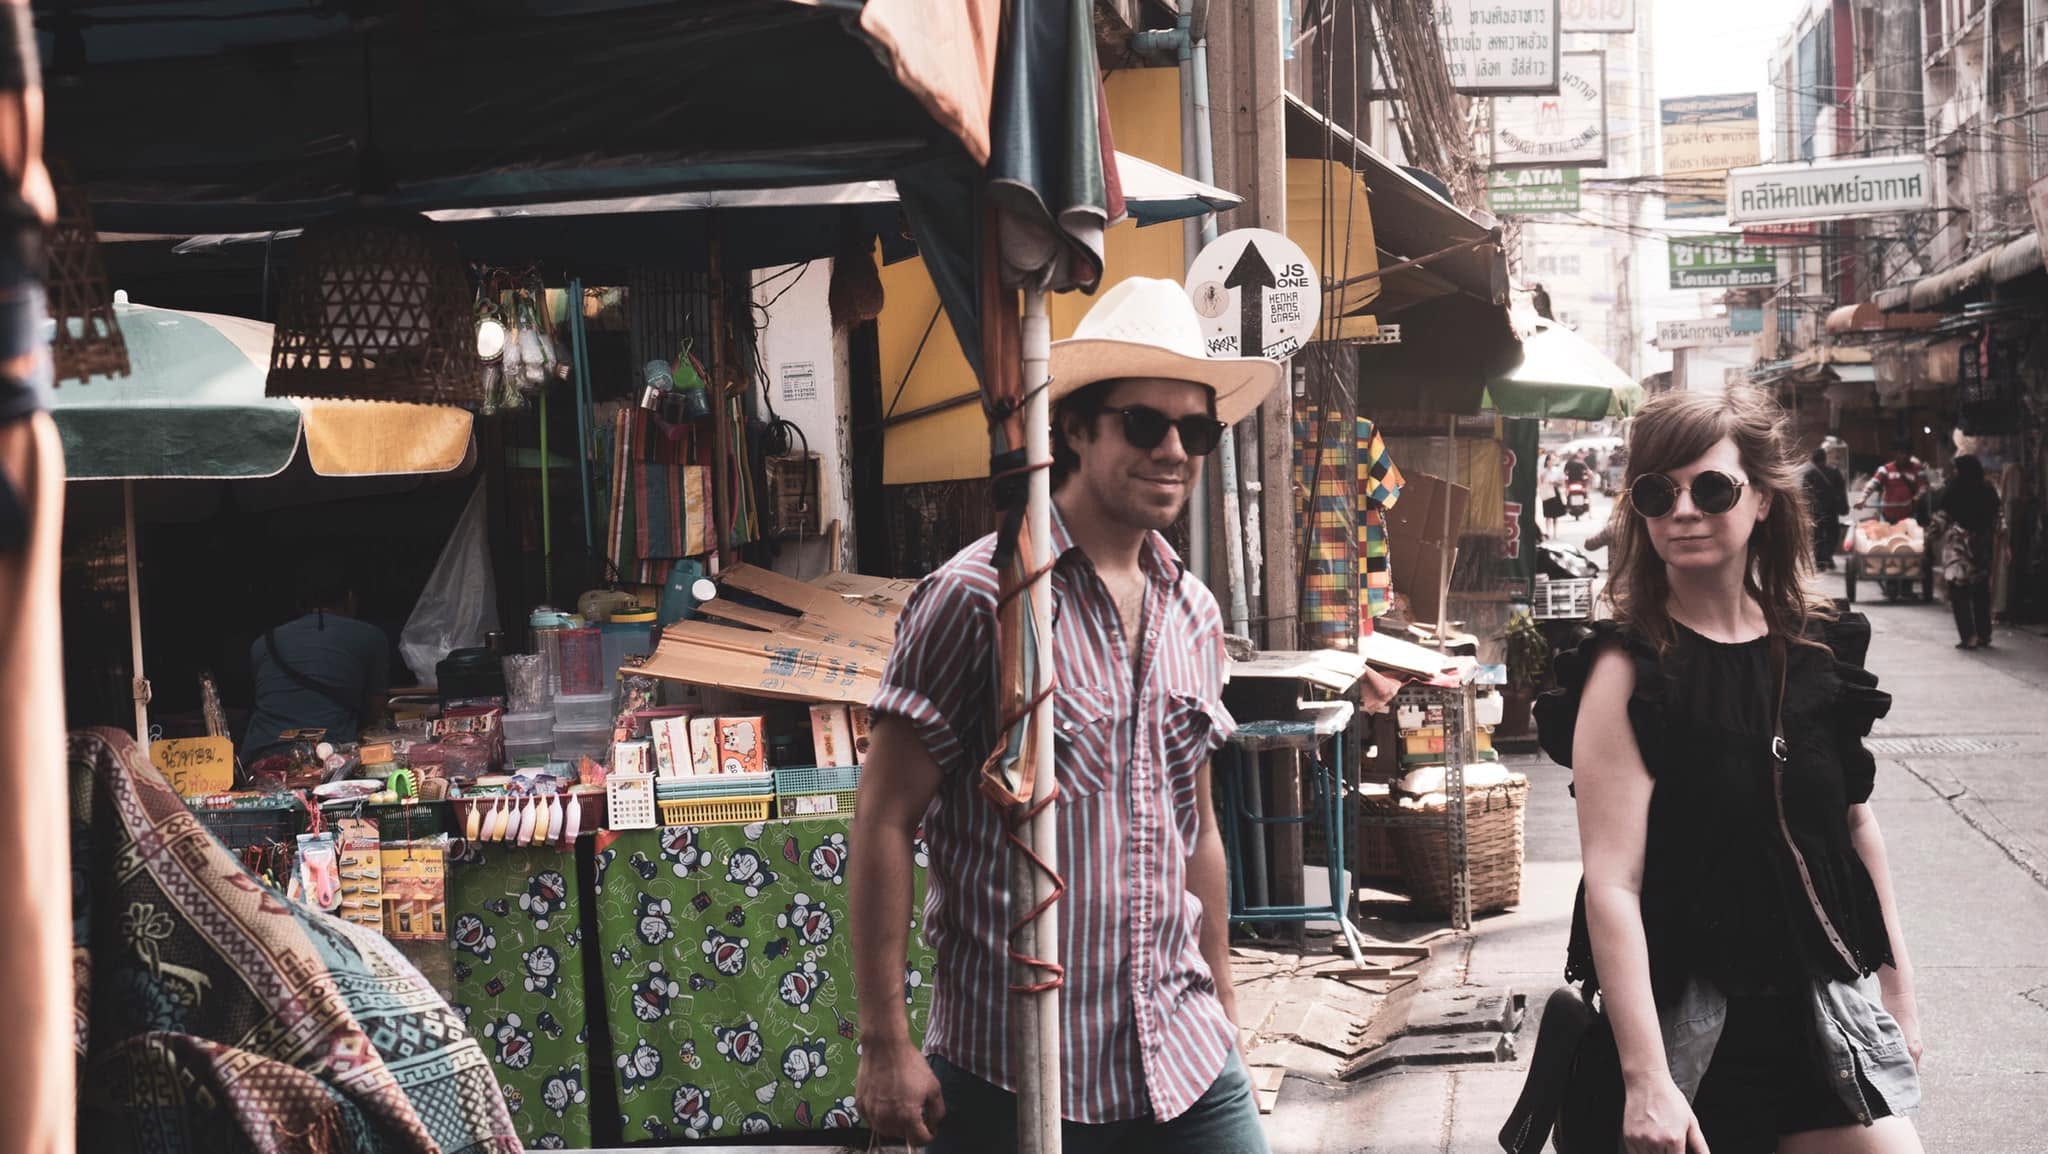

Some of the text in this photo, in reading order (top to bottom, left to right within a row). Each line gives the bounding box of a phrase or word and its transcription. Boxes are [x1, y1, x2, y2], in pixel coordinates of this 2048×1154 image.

[1517, 169, 1562, 186] ATM
[1740, 174, 1922, 212] คลีนิคแพทย์อากาศ
[1280, 263, 1304, 277] JS
[1277, 278, 1309, 288] ONE
[1271, 312, 1300, 324] GNASH
